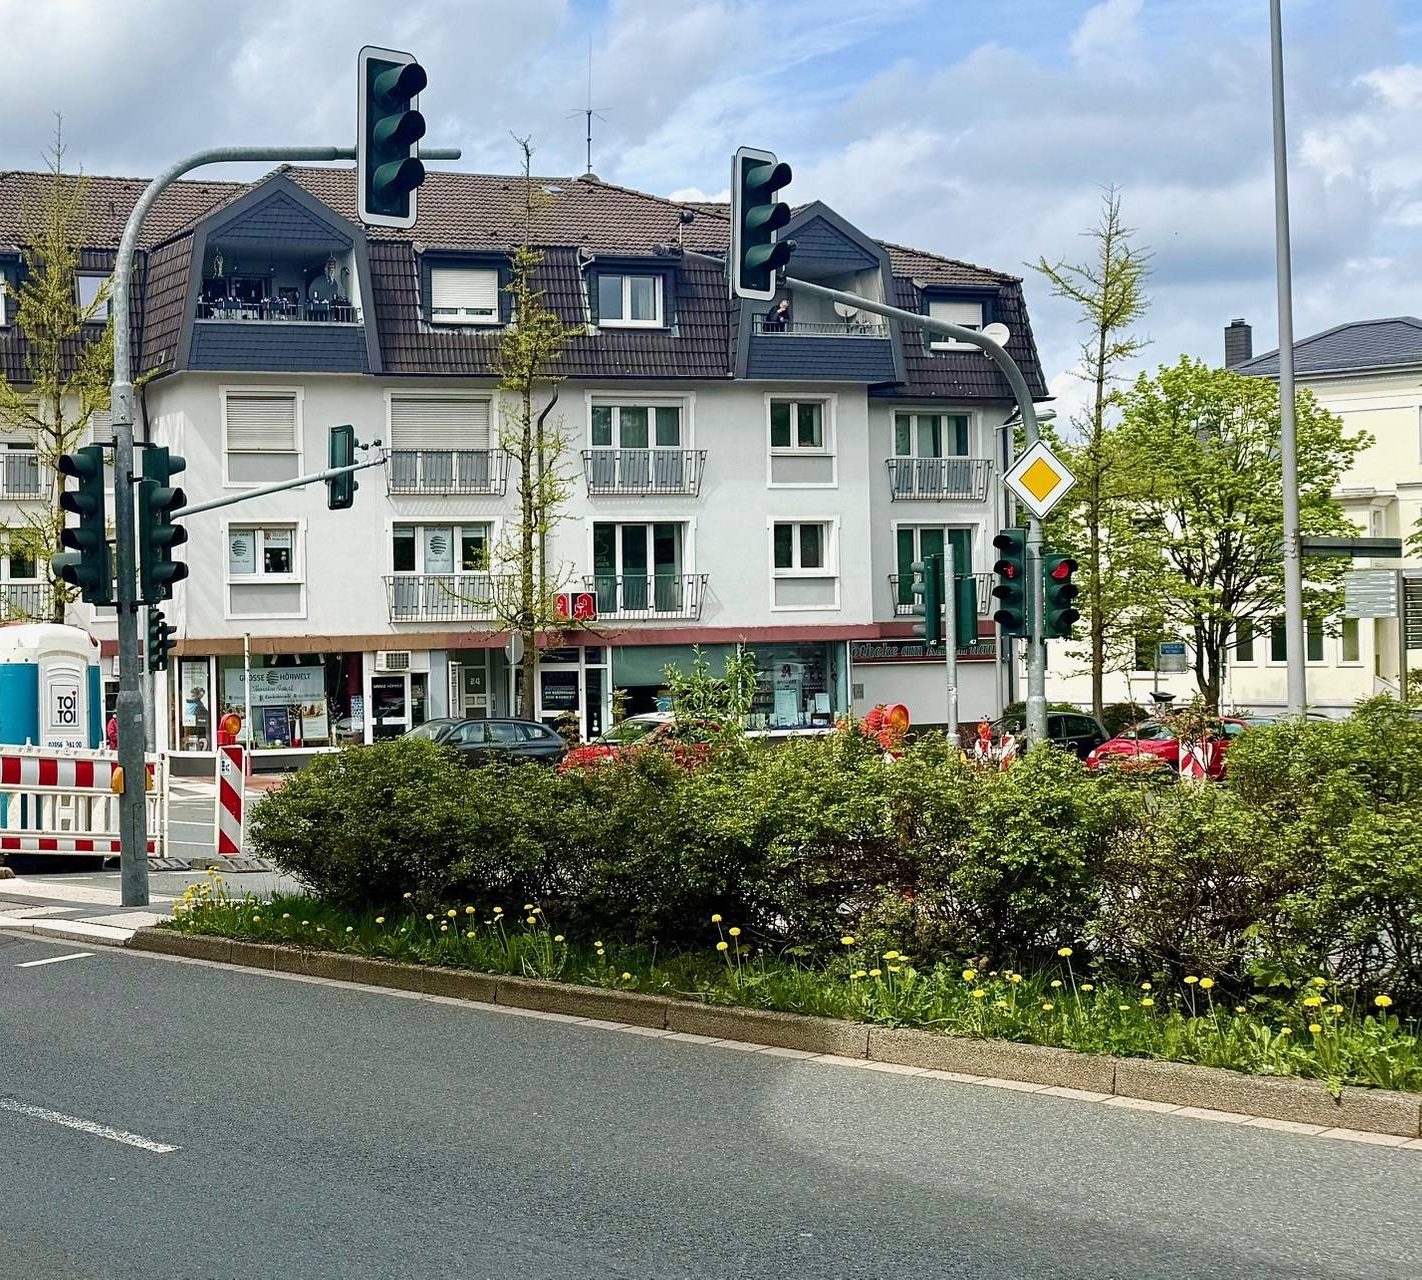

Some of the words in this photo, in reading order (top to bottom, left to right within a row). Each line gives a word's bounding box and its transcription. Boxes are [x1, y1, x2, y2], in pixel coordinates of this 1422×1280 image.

[239, 674, 265, 682] GOSSE
[279, 672, 312, 681] HÖRWELT
[470, 677, 480, 685] 24
[57, 696, 77, 710] TOI
[57, 710, 77, 724] TOI
